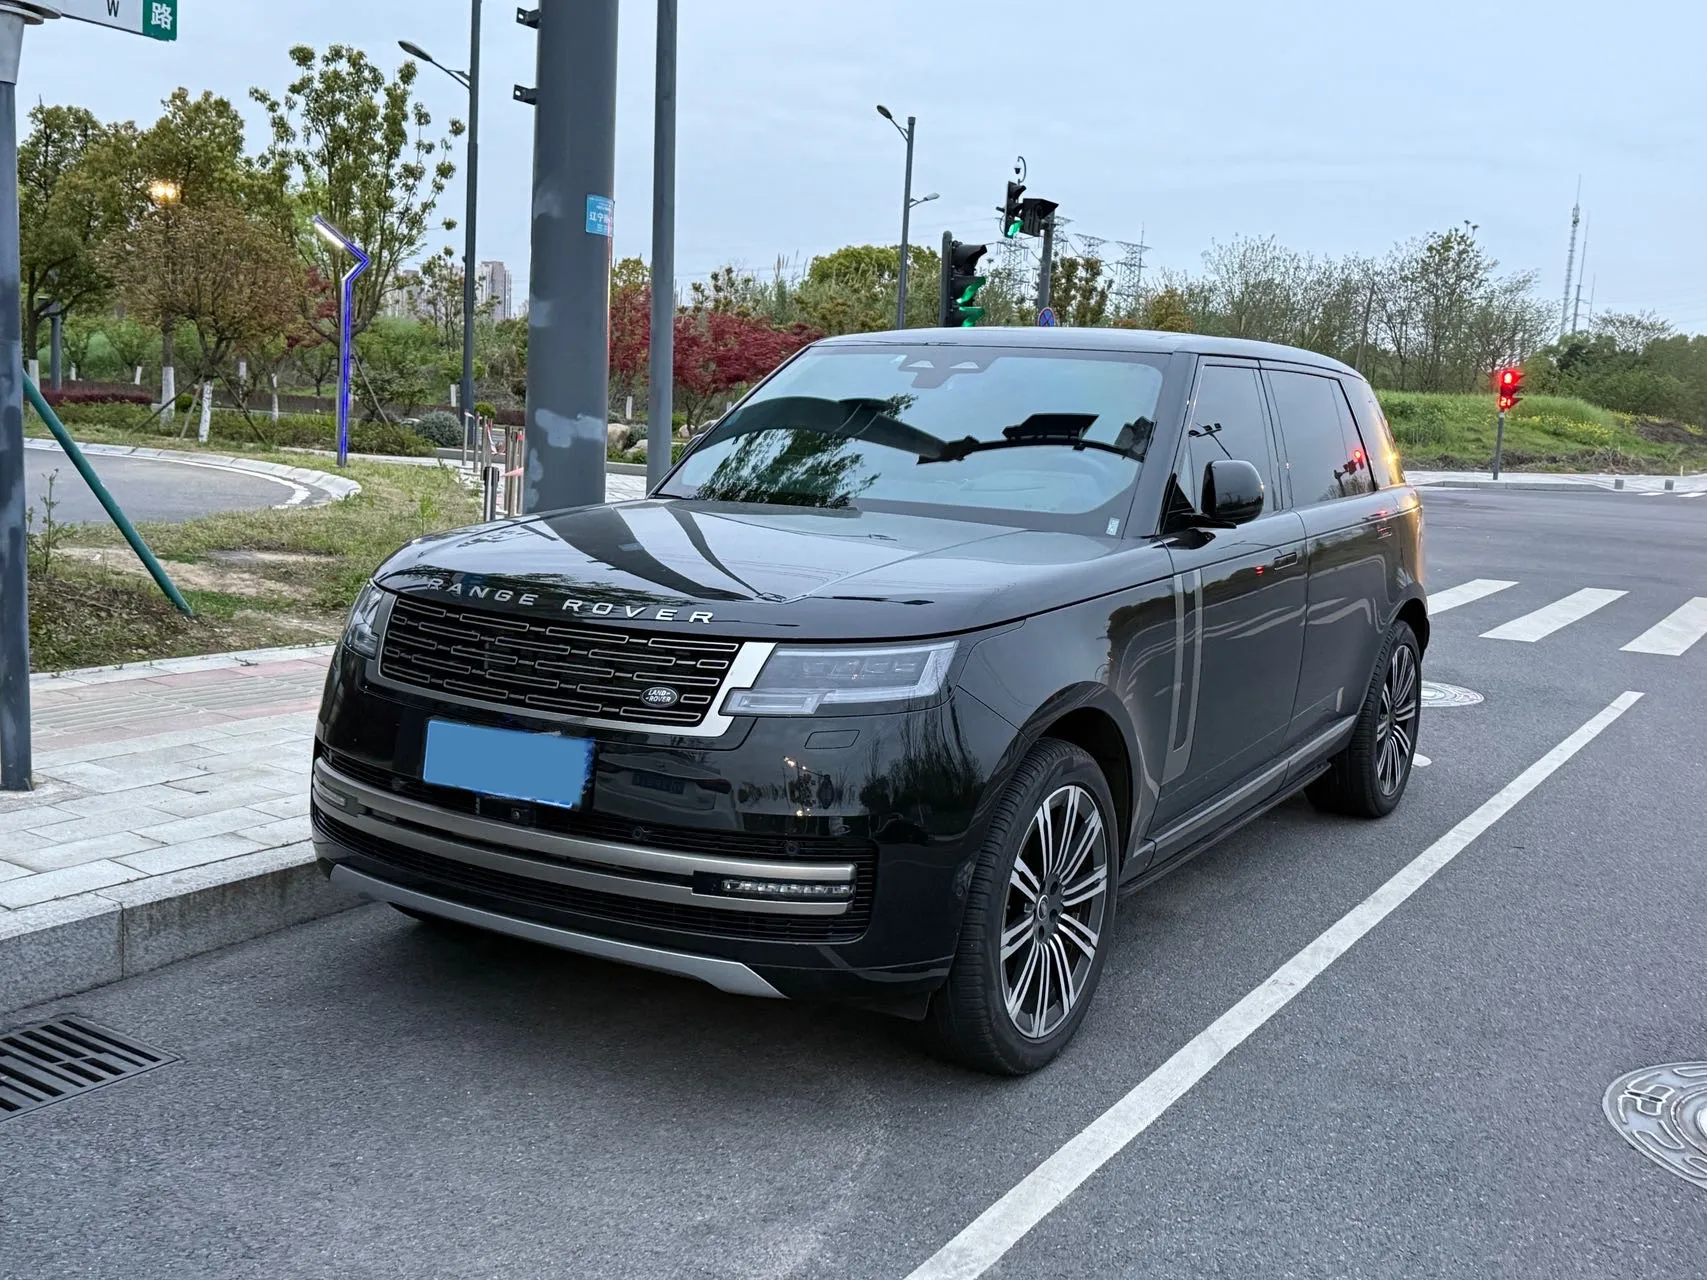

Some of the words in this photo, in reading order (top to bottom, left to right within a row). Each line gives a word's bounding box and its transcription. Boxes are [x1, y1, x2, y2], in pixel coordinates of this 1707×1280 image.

[150, 2, 173, 31] 路
[427, 578, 539, 606] RANGE
[562, 598, 714, 624] ROVER
